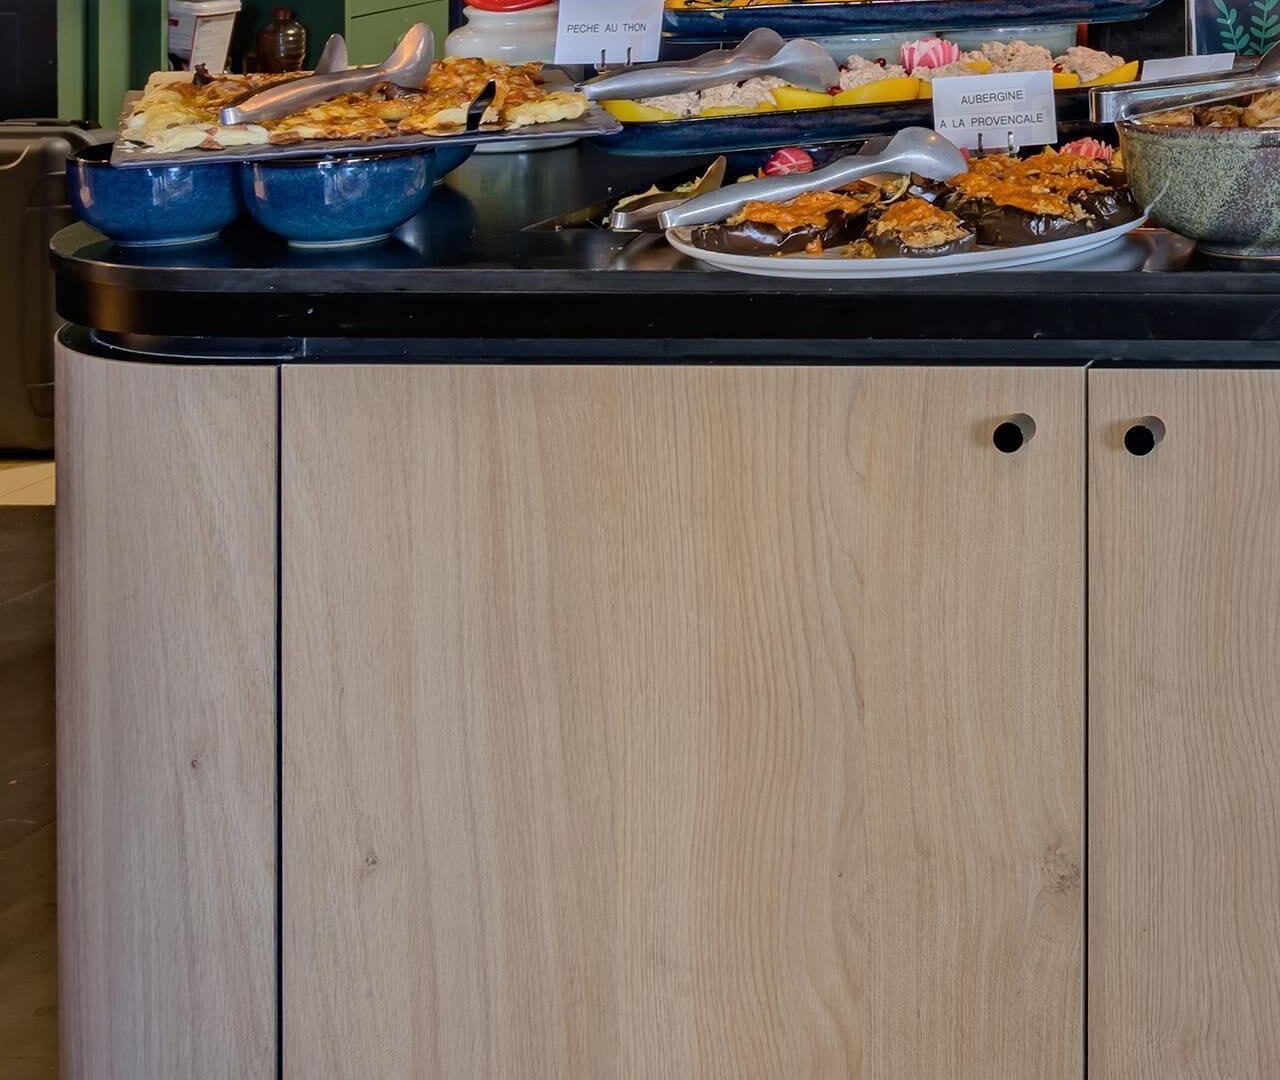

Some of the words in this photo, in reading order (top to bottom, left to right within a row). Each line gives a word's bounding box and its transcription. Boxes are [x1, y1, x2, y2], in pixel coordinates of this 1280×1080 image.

[567, 23, 600, 33] PECHE
[604, 23, 618, 33] AU
[623, 22, 647, 32] THON
[961, 90, 1024, 105] AUBERGINE
[940, 120, 947, 129] A
[952, 119, 965, 128] LA
[971, 113, 1044, 127] PROVENCALE
